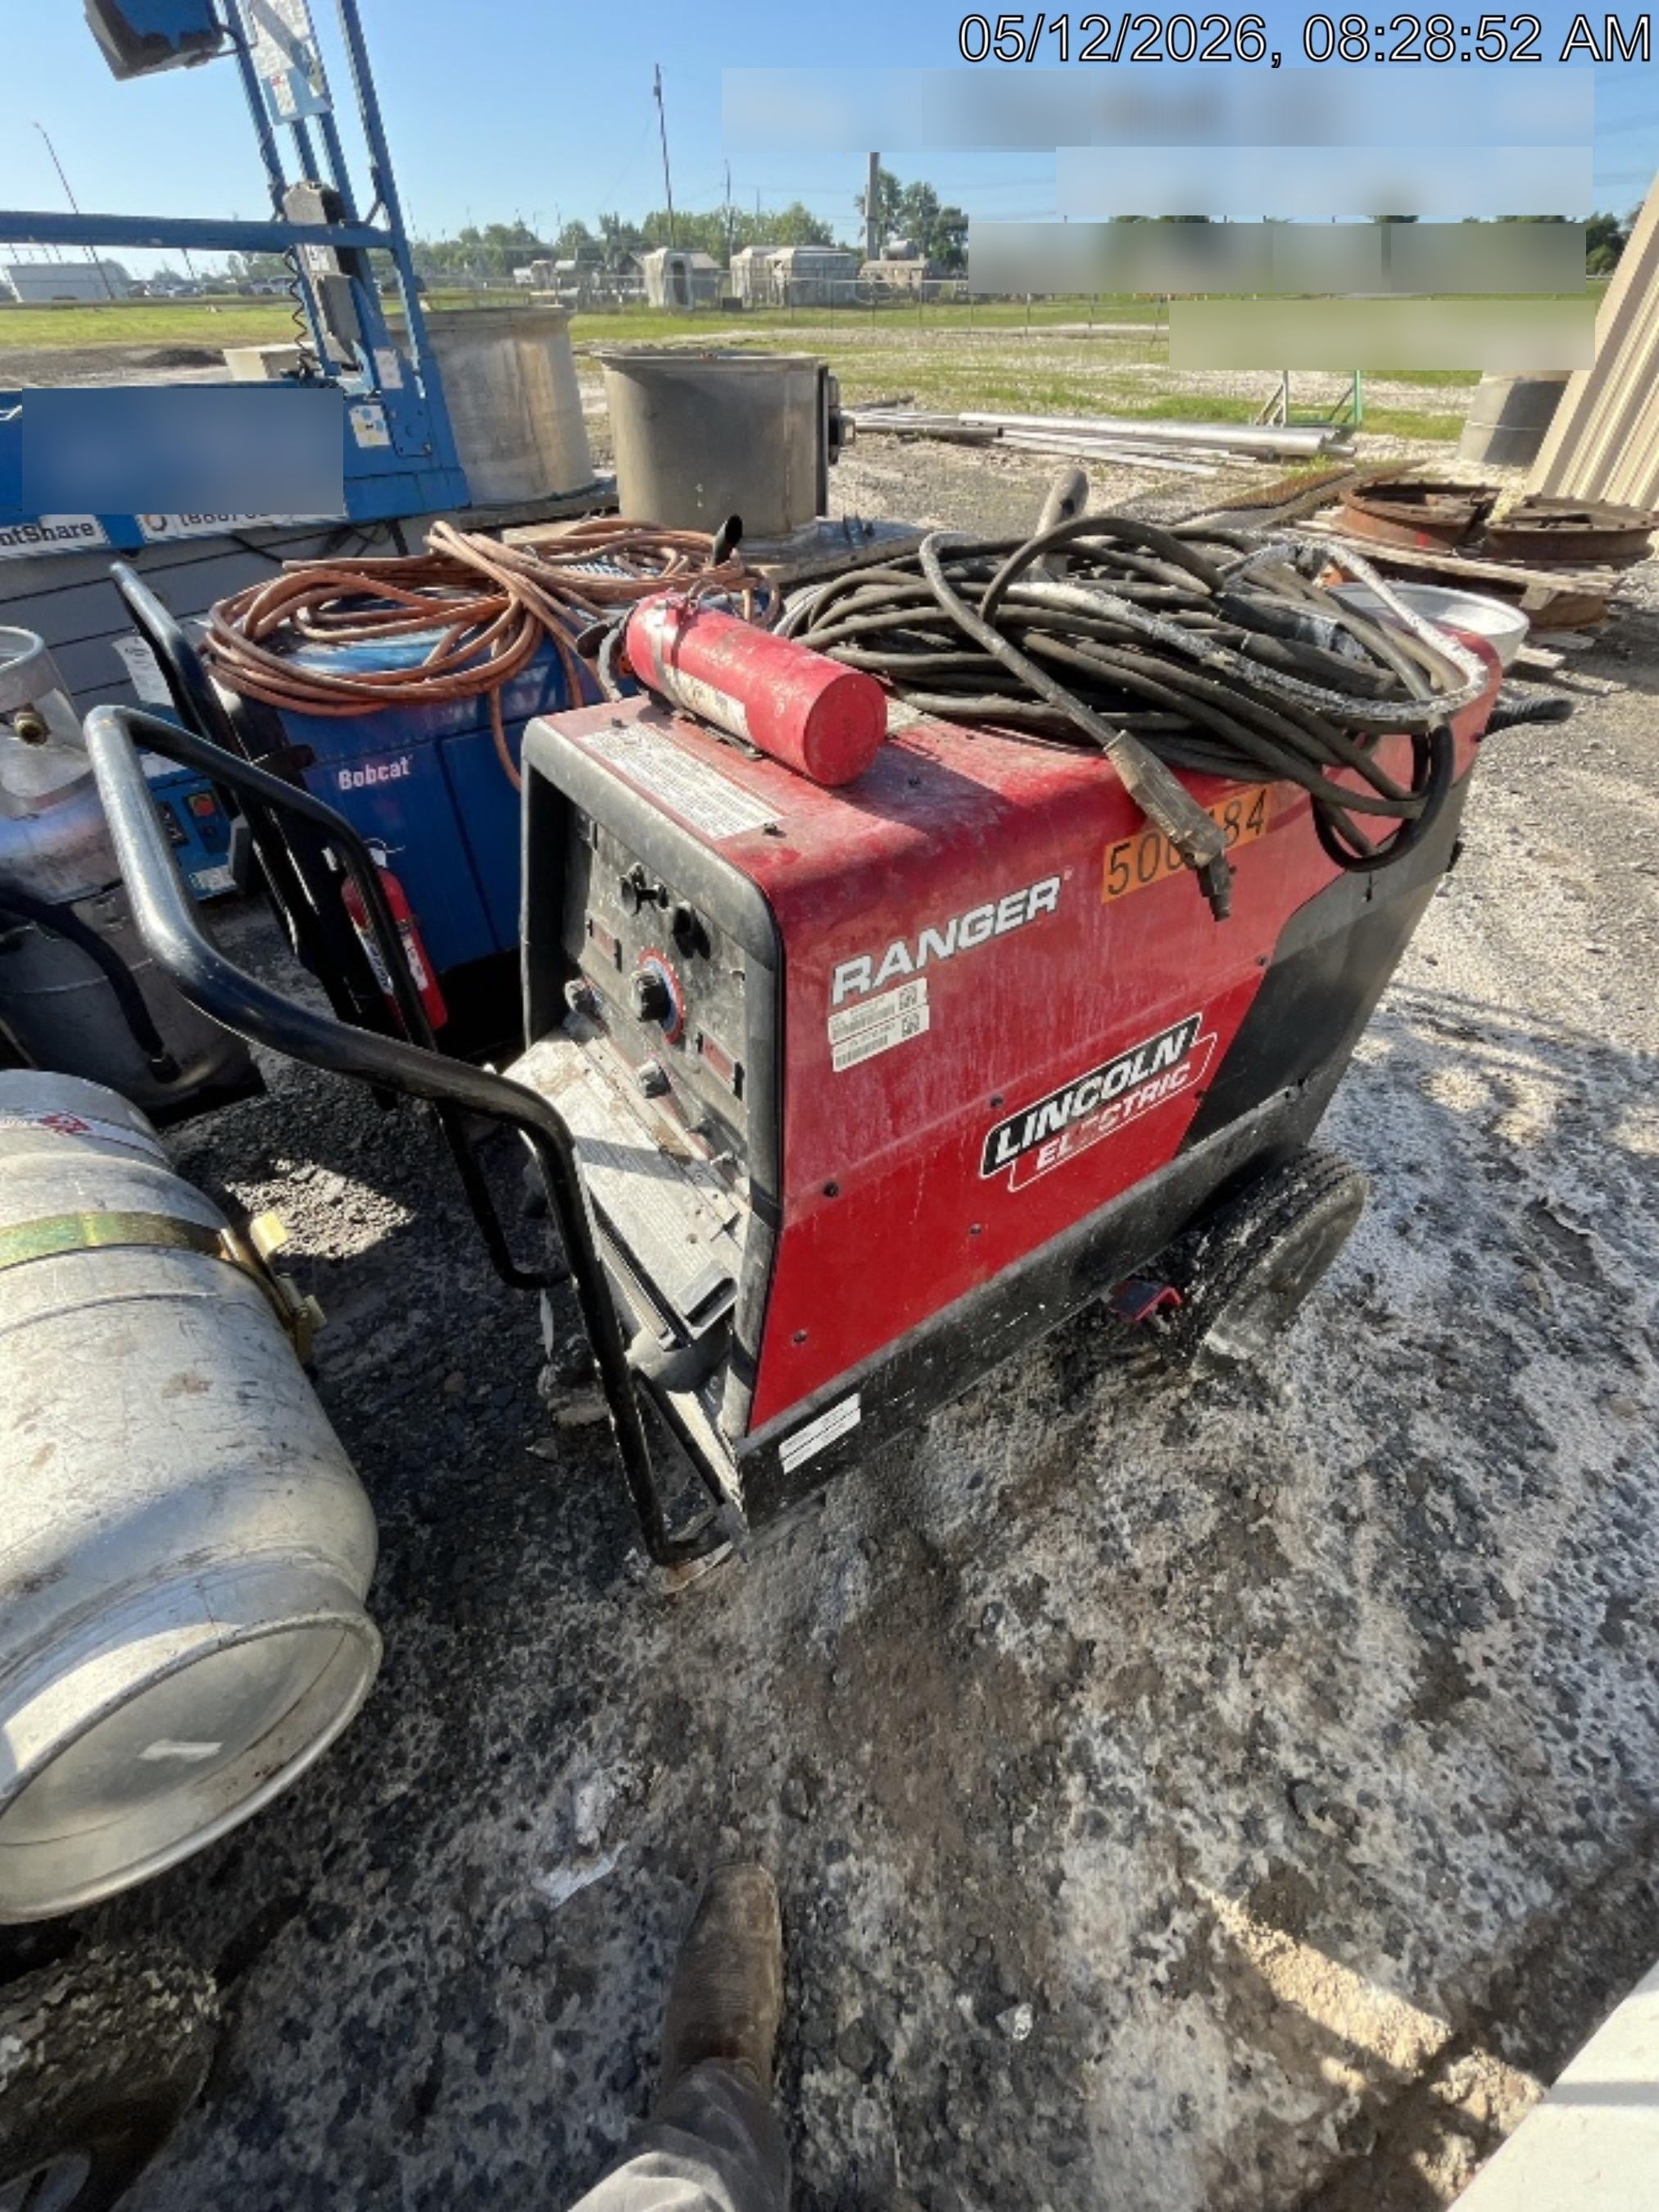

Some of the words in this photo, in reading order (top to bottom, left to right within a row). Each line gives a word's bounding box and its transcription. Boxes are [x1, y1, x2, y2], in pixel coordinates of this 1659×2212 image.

[338, 755, 410, 791] Bobcat
[1108, 788, 1267, 895] 5084
[832, 875, 1061, 1005] RANGER
[995, 1026, 1189, 1164] LINCOLN
